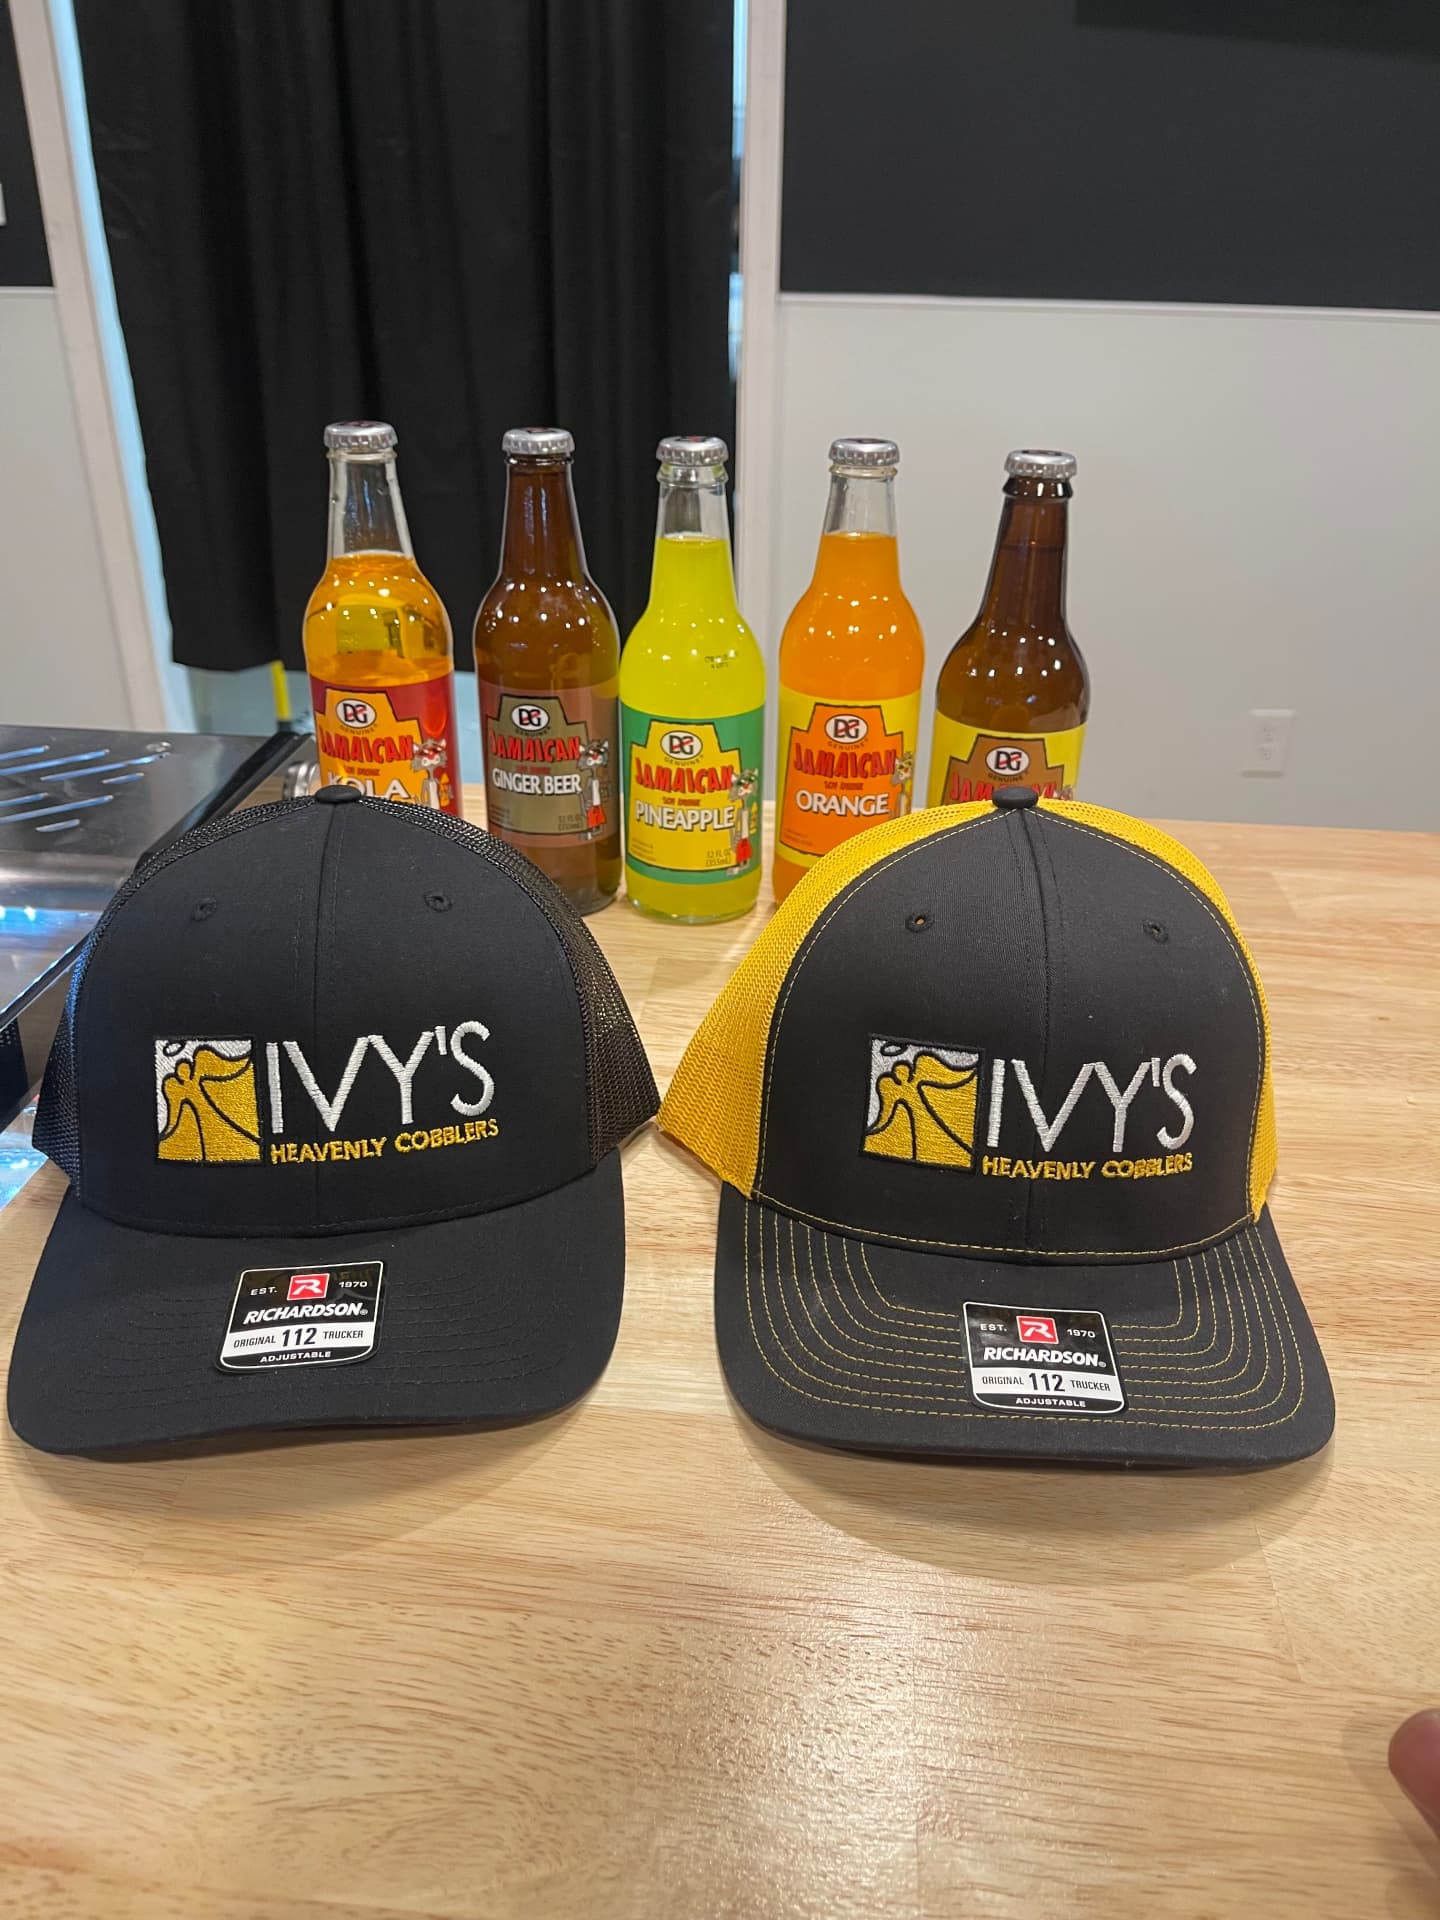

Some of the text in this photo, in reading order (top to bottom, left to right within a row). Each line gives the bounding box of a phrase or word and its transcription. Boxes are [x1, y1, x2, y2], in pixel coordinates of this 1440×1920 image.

[319, 726, 414, 764] JAMAICAN
[490, 728, 581, 762] JAMAICAN
[794, 742, 897, 779] JAMAICAN
[492, 768, 542, 794] GINGER
[544, 774, 582, 796] BEER
[635, 757, 734, 794] JAMAICAN
[635, 800, 735, 832] PINEAPPLE
[796, 789, 890, 816] ORANGE
[266, 1020, 495, 1134] IVY'S
[987, 1053, 1197, 1153] IVY'S
[270, 1119, 499, 1164] HEAVENLY COBBLERS
[982, 1152, 1193, 1180] HEAVENLY COBBLERS
[250, 1286, 278, 1296] EST.
[233, 1327, 364, 1348] ORIGINAL 112 TRUCKER
[980, 1323, 1007, 1332] EST.
[1066, 1328, 1096, 1339] 1970
[260, 1351, 332, 1363] ADJUSTABLE
[982, 1372, 1111, 1393] ORIGINAL 112 TRUCKER
[1015, 1397, 1087, 1408] ADJUSTABLE
